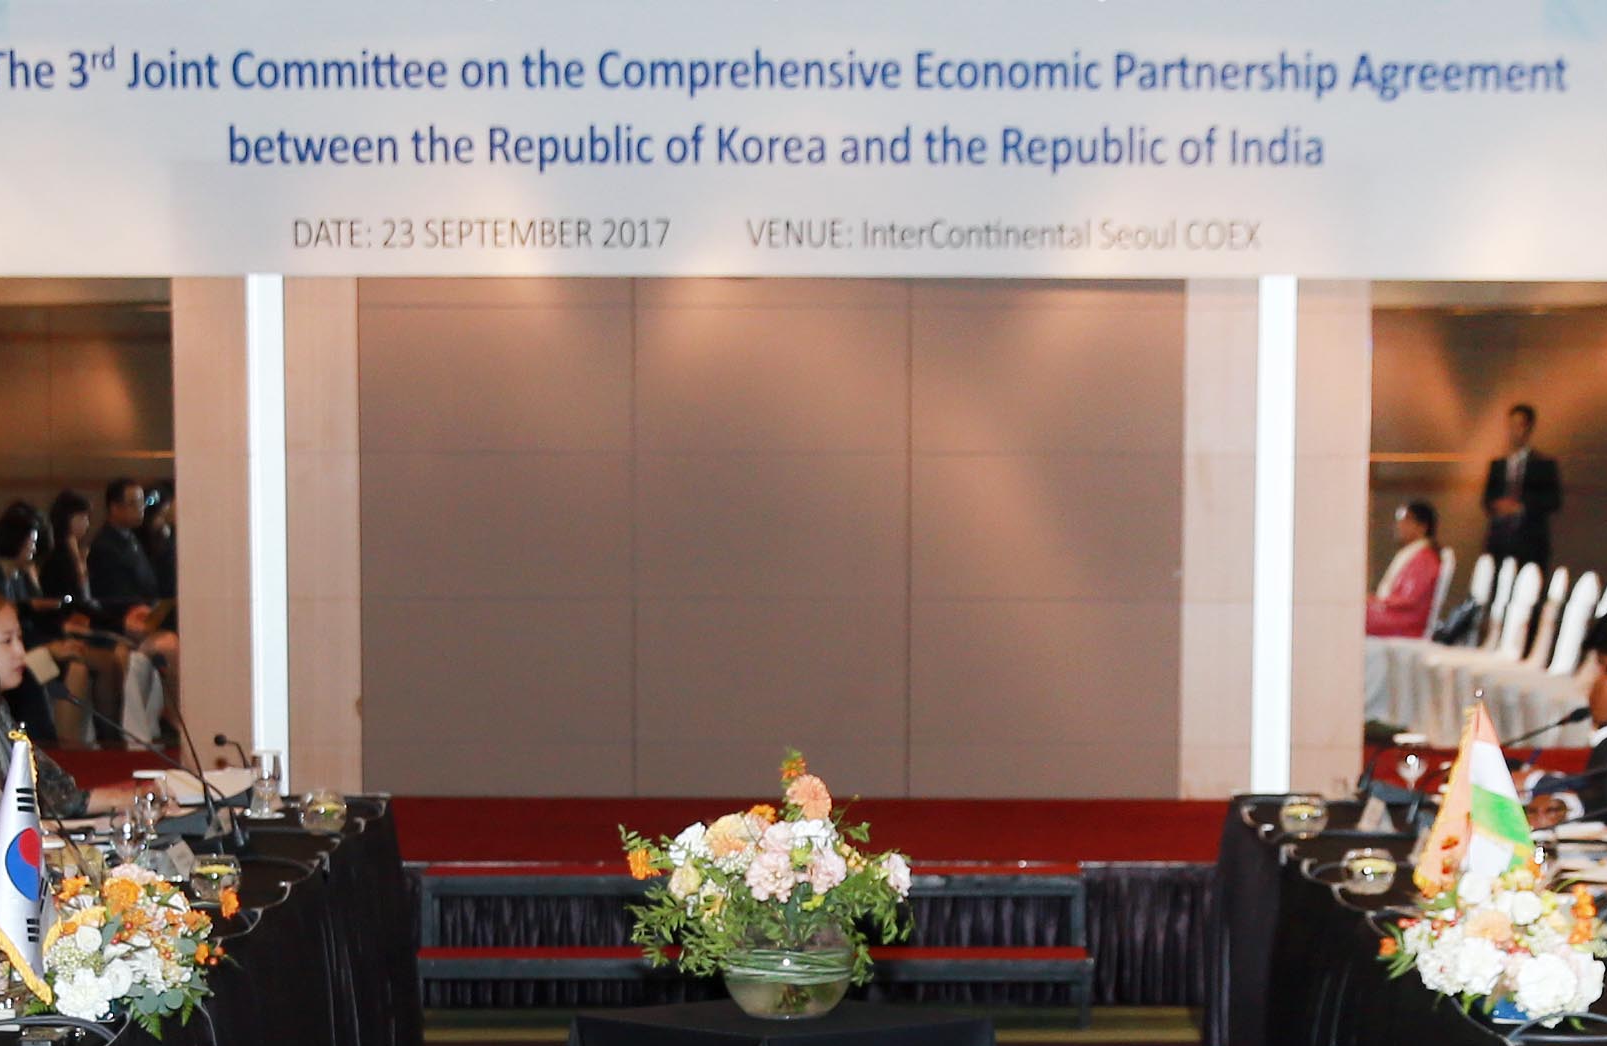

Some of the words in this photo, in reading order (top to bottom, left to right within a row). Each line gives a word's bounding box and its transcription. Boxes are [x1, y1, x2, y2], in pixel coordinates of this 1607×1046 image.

[69, 45, 116, 90] 3rd
[127, 48, 220, 90] Joint
[231, 49, 449, 90] Committee
[460, 59, 510, 90] on
[521, 48, 586, 90] the
[597, 48, 902, 99] Comprehensive
[915, 50, 1102, 91] Economic
[1114, 51, 1339, 100] Partnership
[1350, 53, 1567, 102] Agreement
[228, 123, 399, 166] between
[411, 124, 475, 166] the
[489, 124, 655, 174] Republic
[665, 124, 706, 166] of
[717, 126, 827, 166] Korea
[840, 125, 912, 166] and
[924, 125, 989, 166] the
[1001, 126, 1167, 174] Republic
[1179, 126, 1218, 166] of
[1230, 126, 1325, 167] India
[292, 218, 372, 249] DATE:
[383, 218, 415, 249] 23
[424, 218, 593, 249] SEPTEMBER
[602, 217, 671, 249] 2017
[747, 218, 853, 249] VENUE:
[863, 219, 1091, 250] InterContinental
[1102, 220, 1176, 249] Seoul
[1186, 220, 1260, 250] COEX
